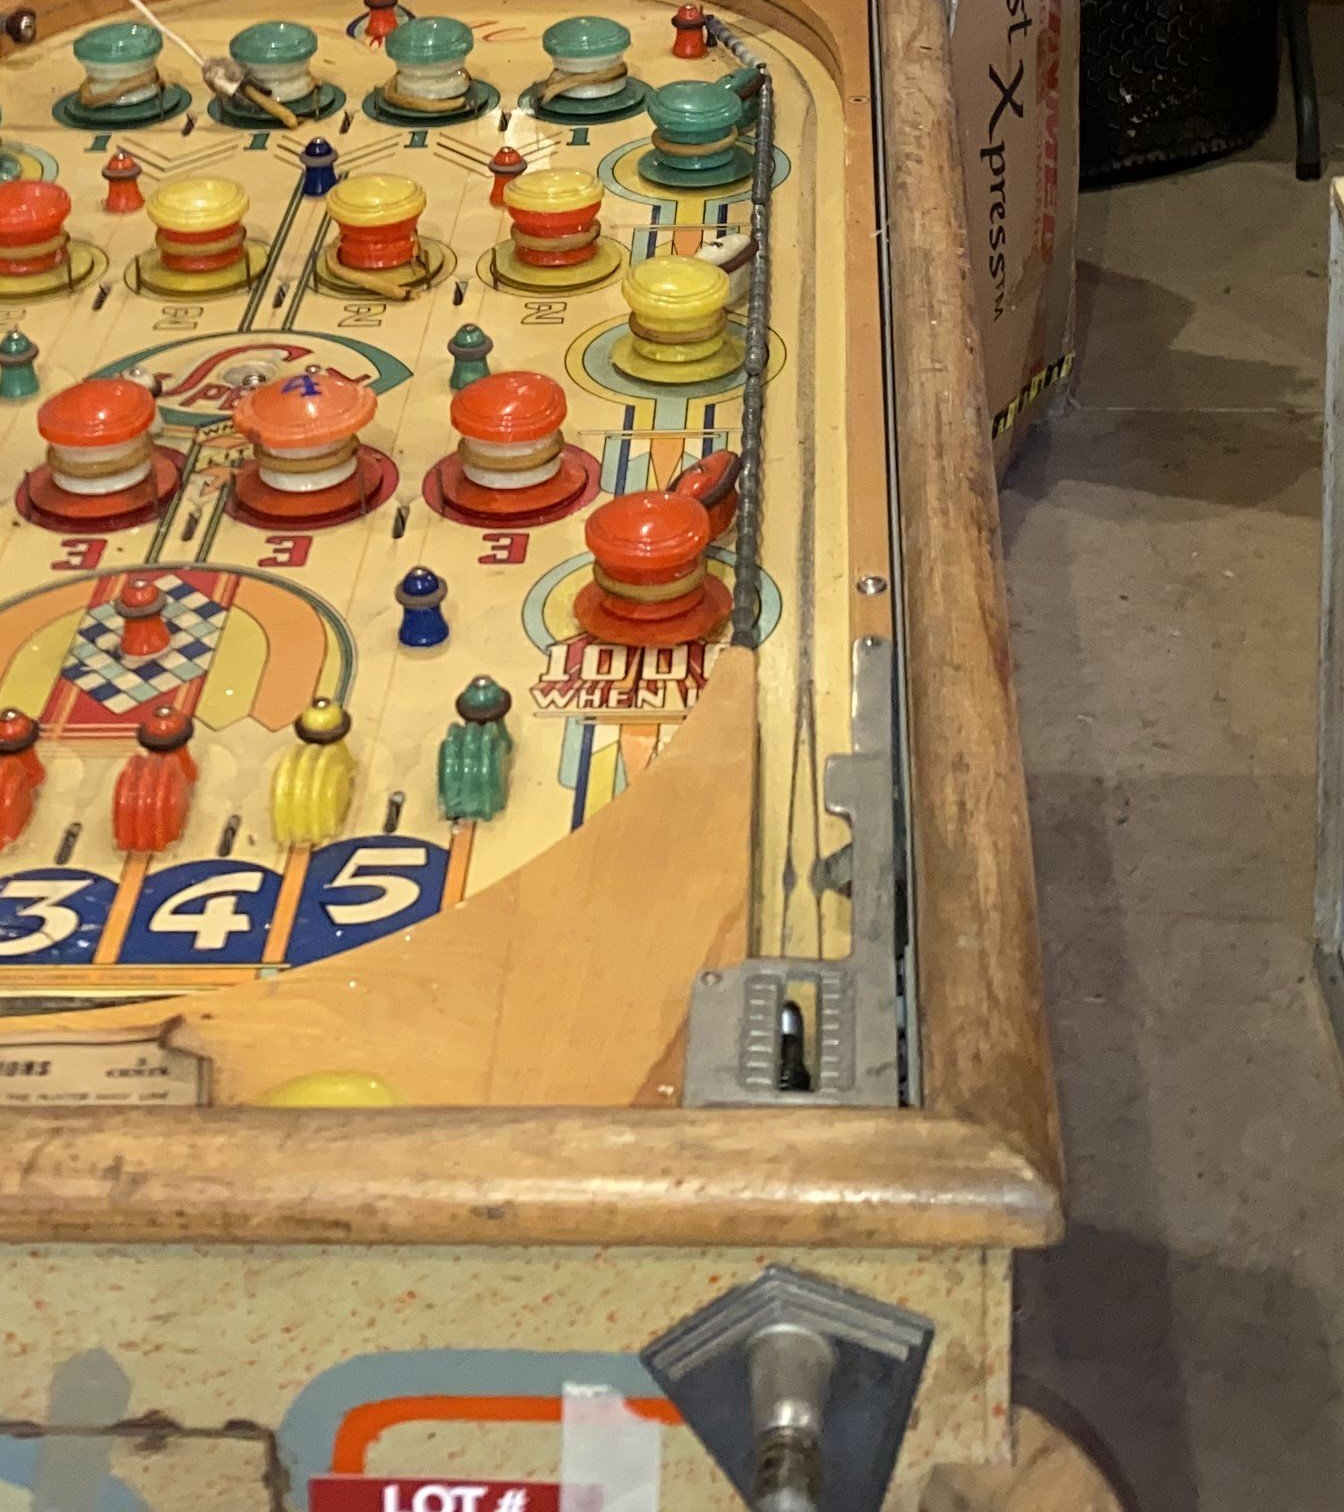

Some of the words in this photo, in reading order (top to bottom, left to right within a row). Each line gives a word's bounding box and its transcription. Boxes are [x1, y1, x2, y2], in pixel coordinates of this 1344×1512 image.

[530, 687, 666, 710] WHEN
[147, 872, 266, 950] 4
[322, 847, 428, 926] 5
